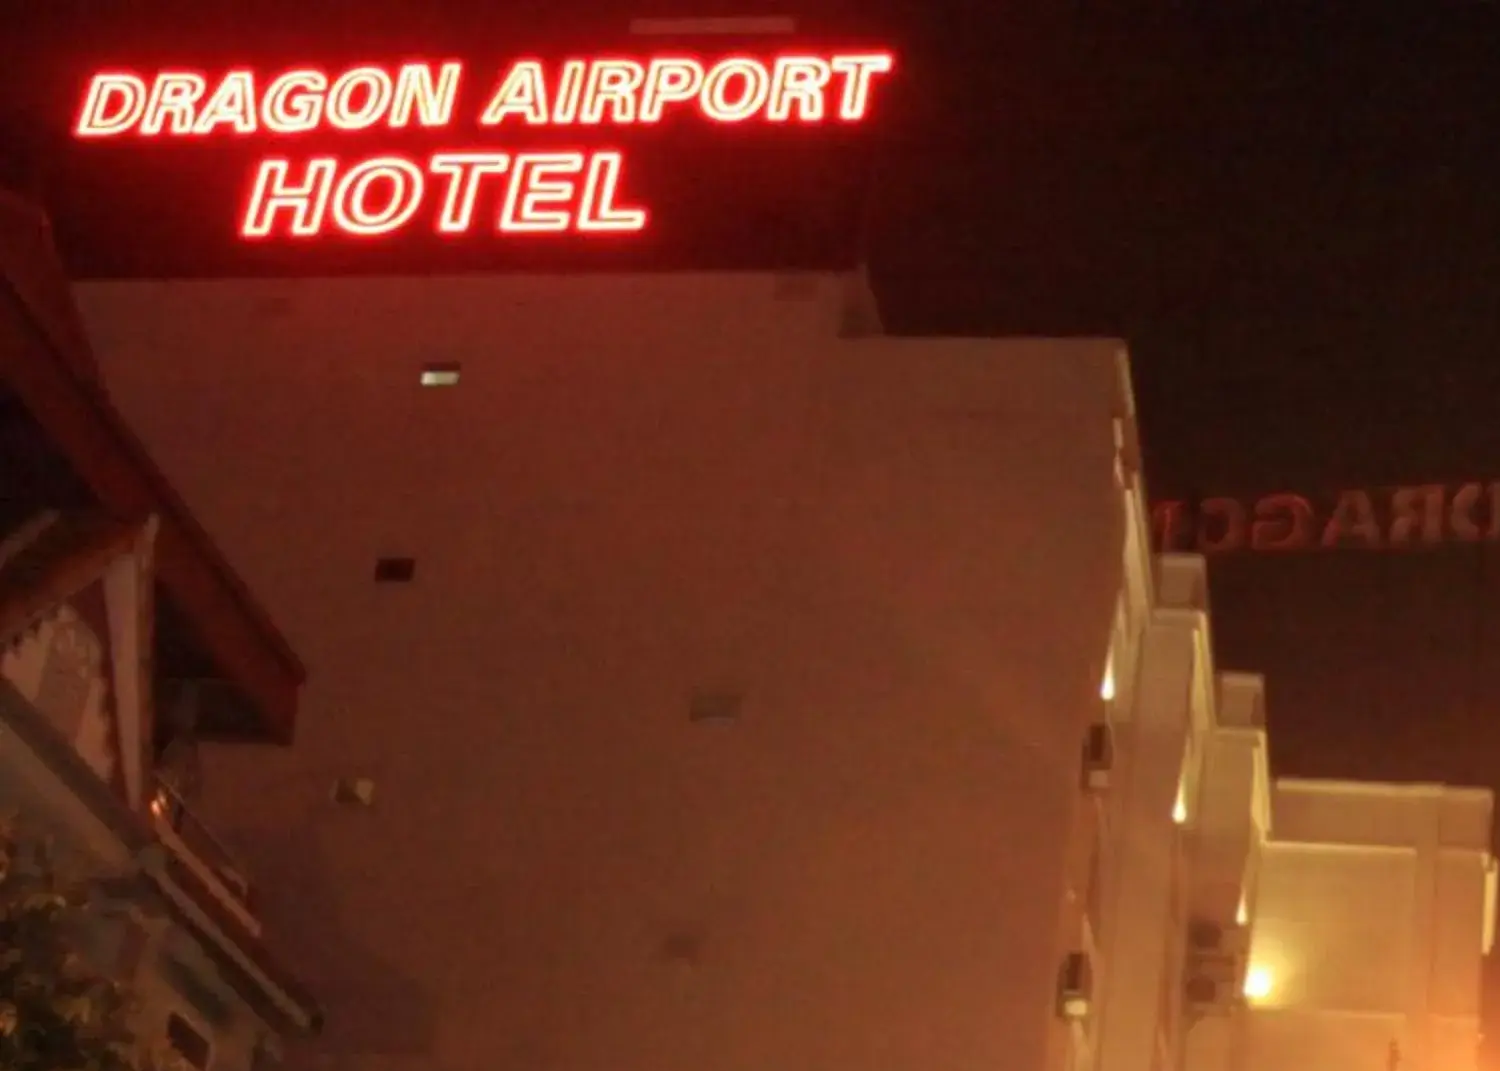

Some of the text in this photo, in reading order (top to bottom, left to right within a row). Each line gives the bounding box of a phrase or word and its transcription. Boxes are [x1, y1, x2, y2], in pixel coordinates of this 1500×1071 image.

[75, 54, 893, 138] DRAGON AIRPORT
[241, 153, 648, 237] HOTEL
